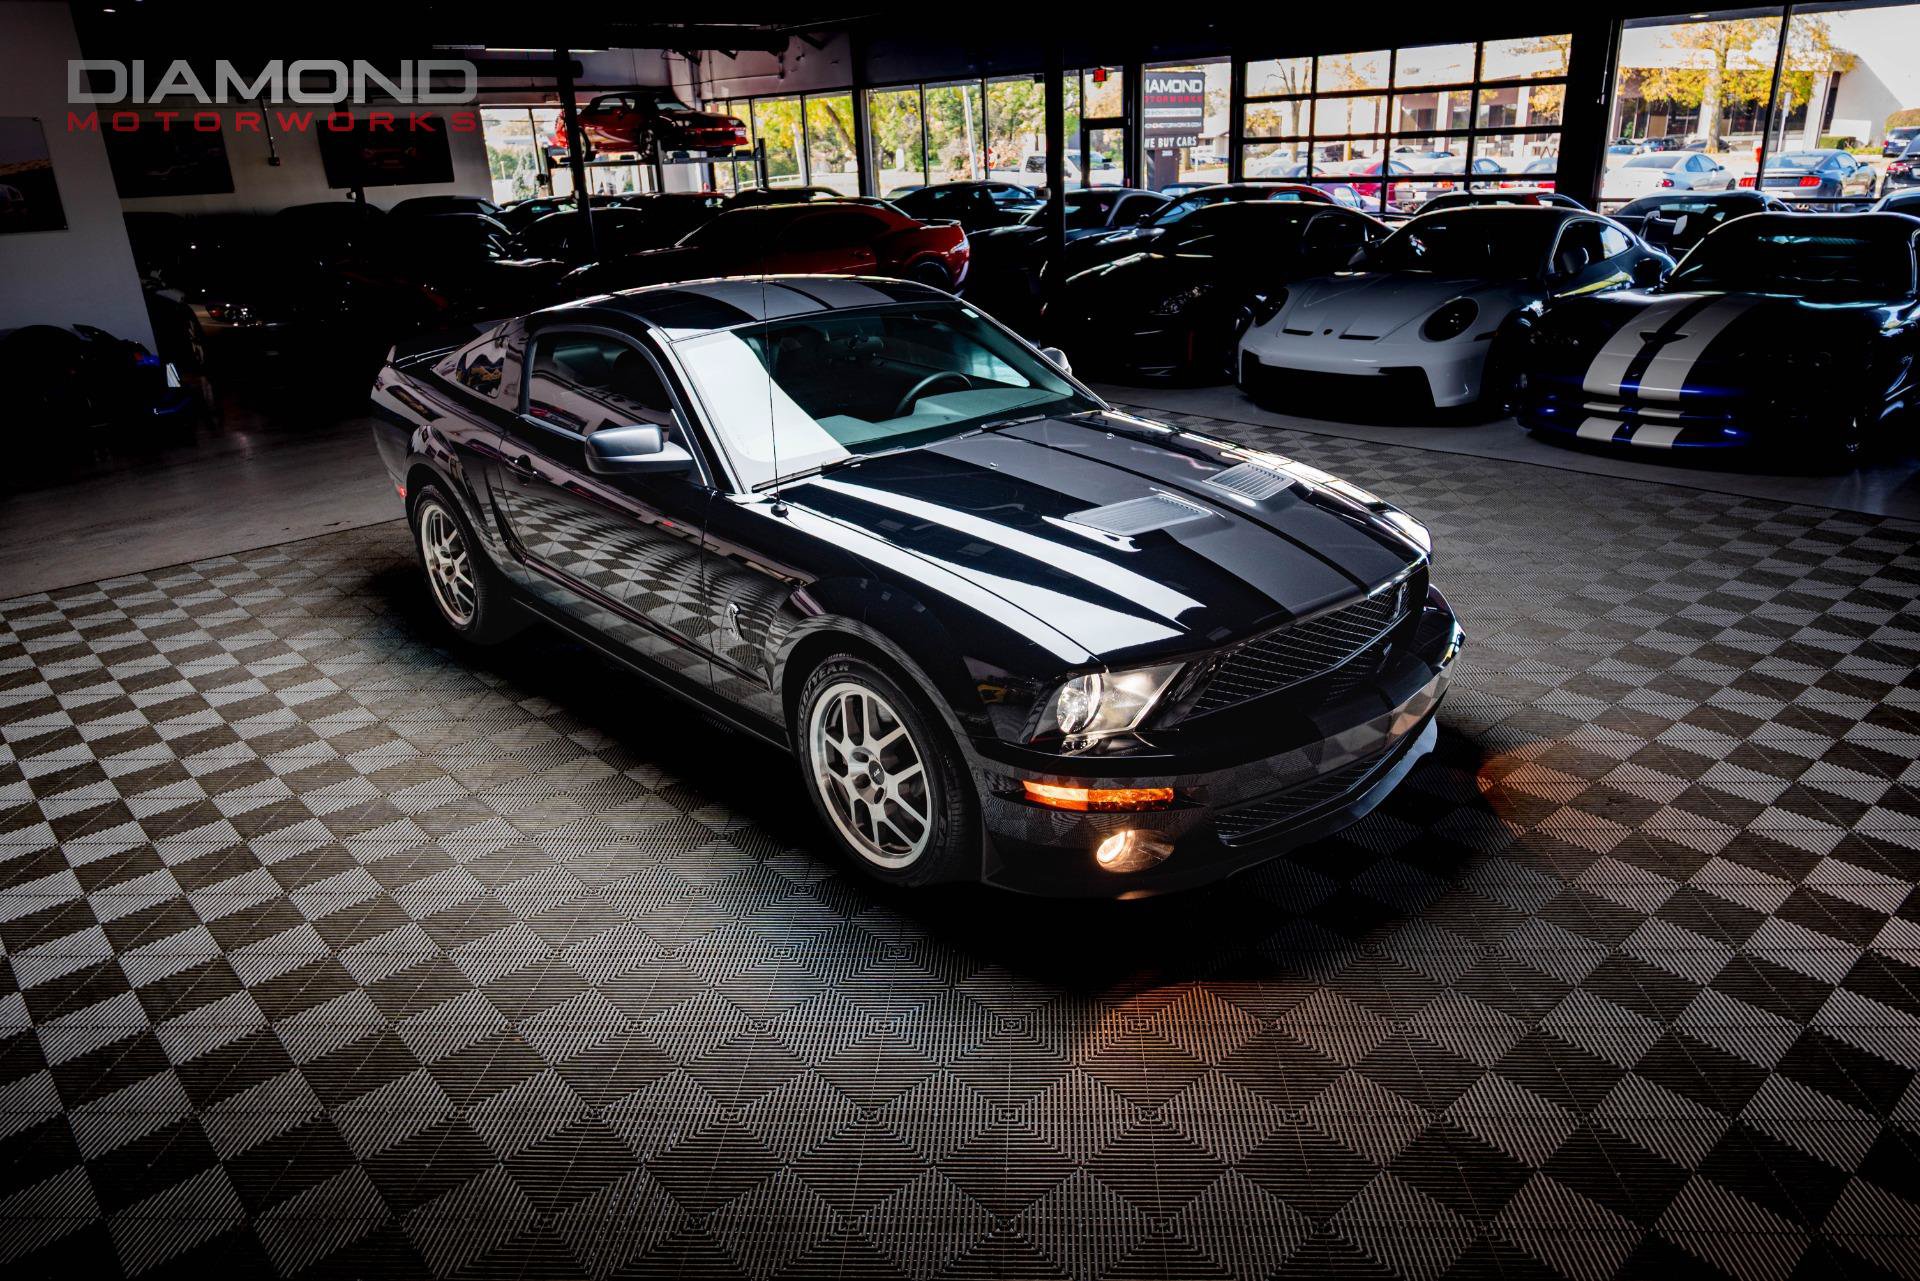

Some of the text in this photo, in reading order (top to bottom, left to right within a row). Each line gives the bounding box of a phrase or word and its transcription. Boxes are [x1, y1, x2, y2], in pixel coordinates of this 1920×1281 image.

[1144, 79, 1203, 93] IAMOND
[1157, 137, 1175, 148] BUY
[1176, 136, 1197, 147] CARS
